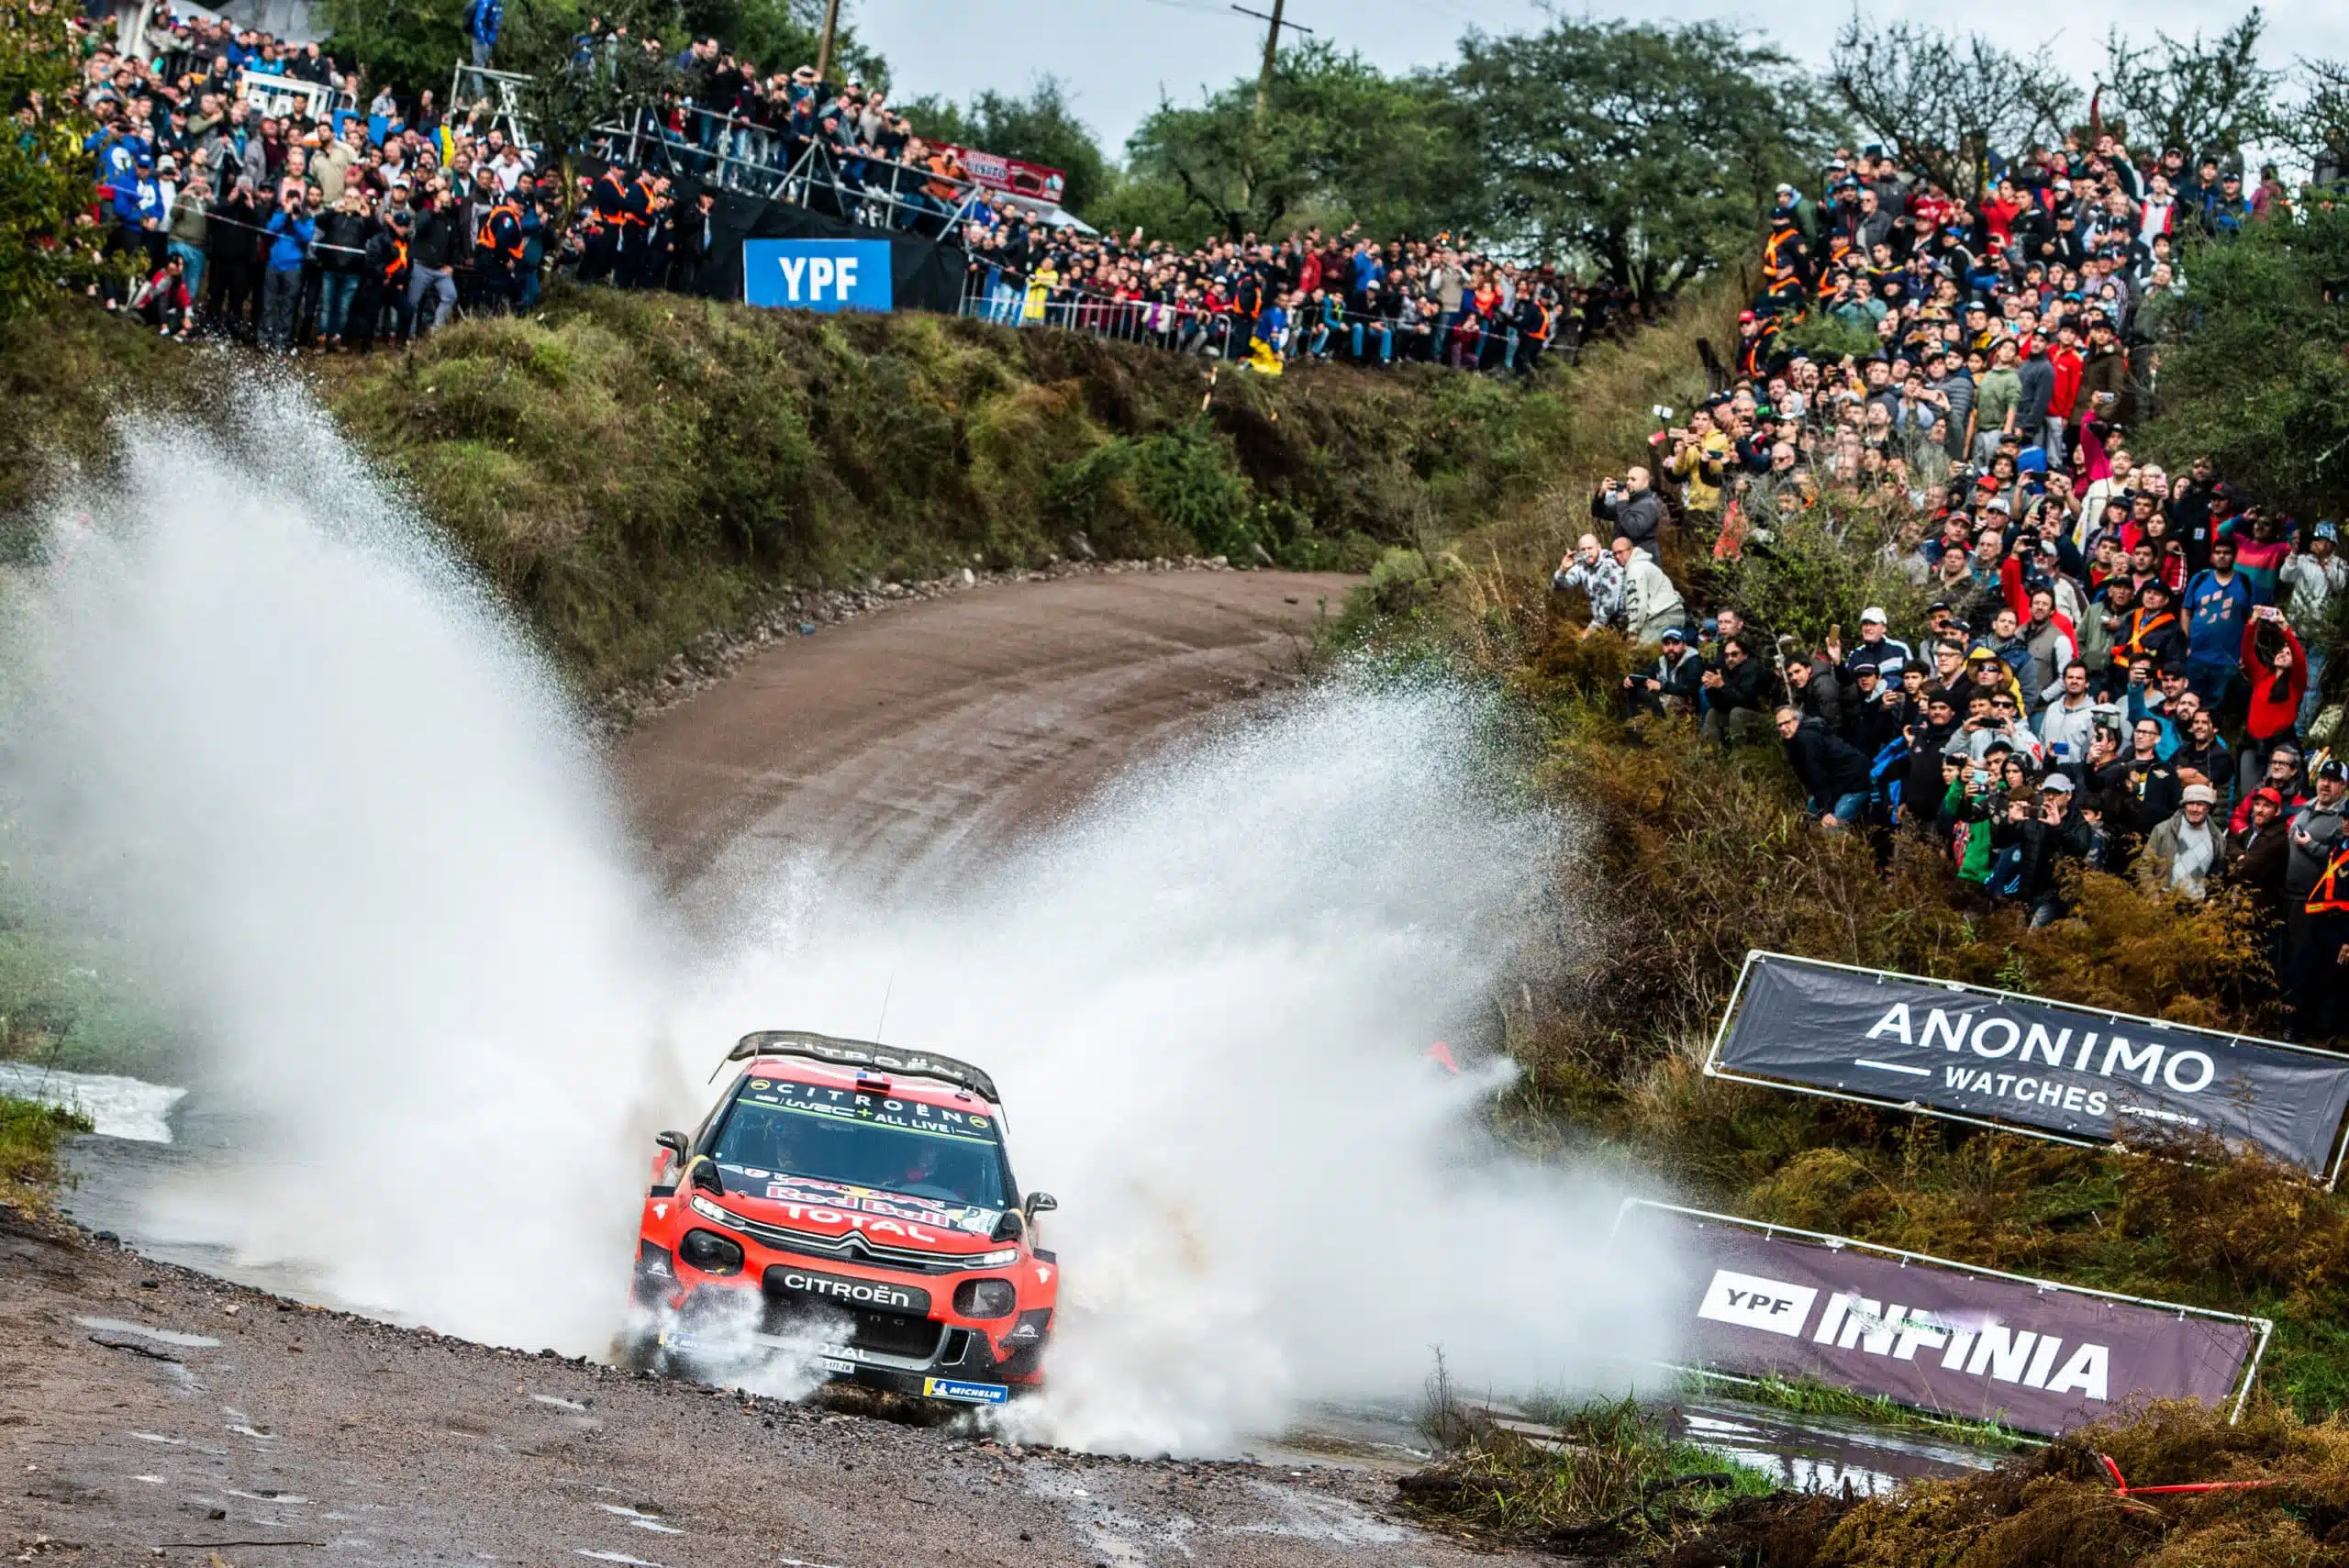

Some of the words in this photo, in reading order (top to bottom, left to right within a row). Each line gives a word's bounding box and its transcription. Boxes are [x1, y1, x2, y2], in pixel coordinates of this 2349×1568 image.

[778, 257, 858, 301] YPF
[1865, 1002, 2215, 1094] ANONIMO
[777, 1084, 963, 1124] CITROËN
[1945, 1066, 2109, 1116] WATCHES
[874, 1113, 907, 1127] ALL
[911, 1119, 950, 1134] LIVE
[766, 1184, 858, 1210] Red
[863, 1199, 950, 1228] Bull
[780, 1203, 936, 1243] TOTAL
[785, 1273, 909, 1307] CITROËN
[1727, 1288, 1793, 1316] YPF
[950, 1387, 1002, 1399] MICHELIN
